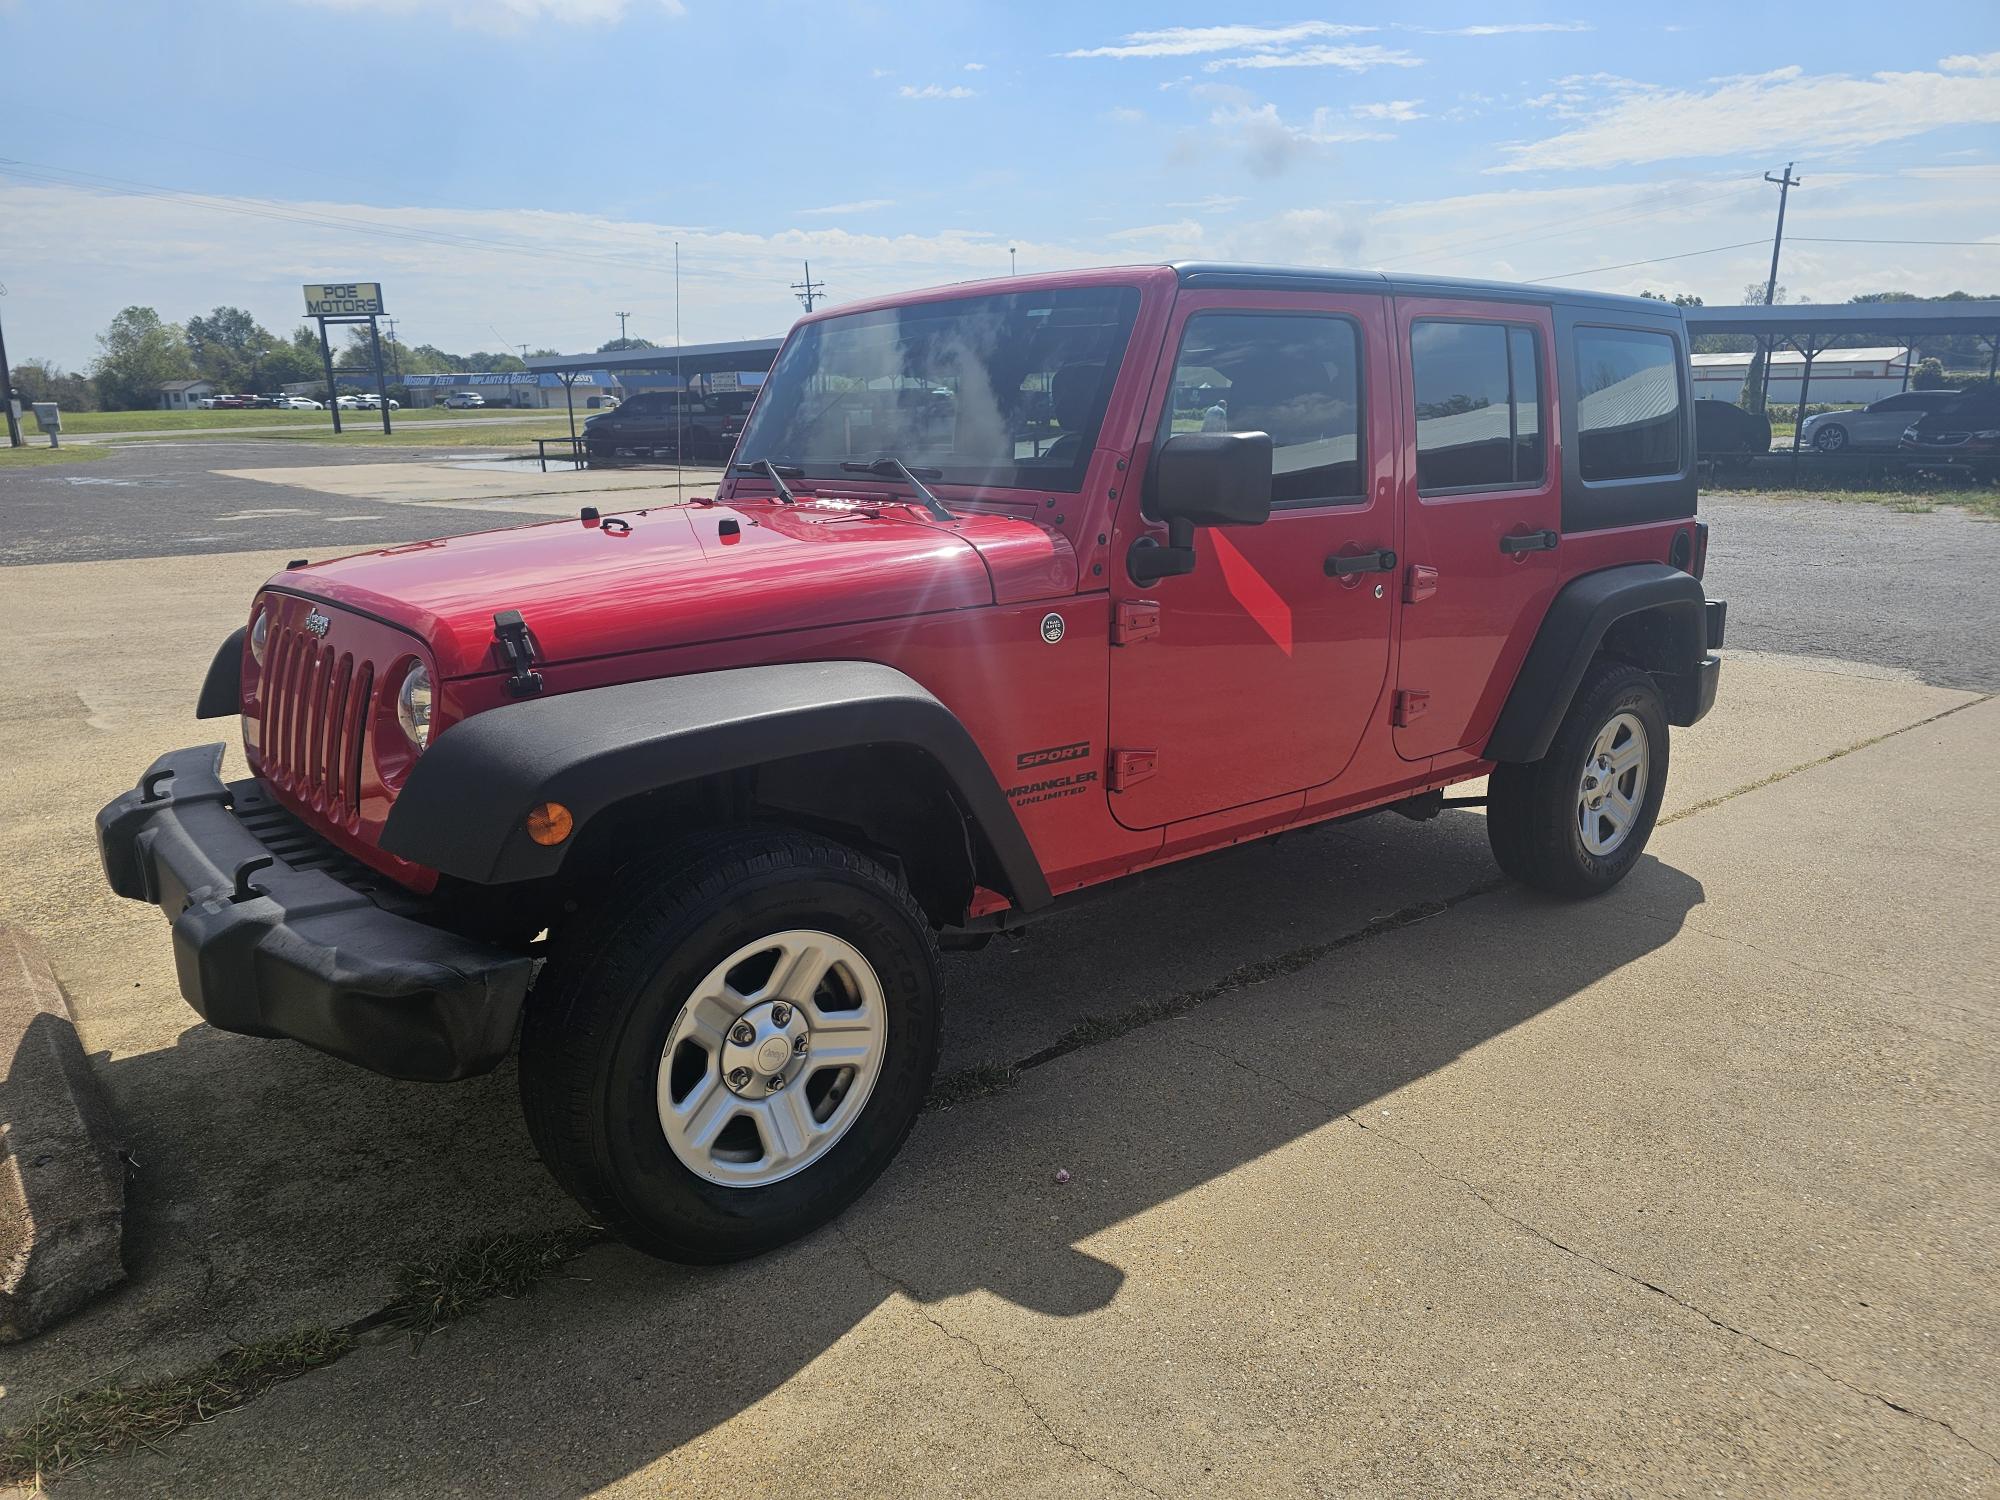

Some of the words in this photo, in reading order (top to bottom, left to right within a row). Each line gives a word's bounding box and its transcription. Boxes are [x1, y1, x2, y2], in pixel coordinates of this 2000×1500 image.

[323, 286, 357, 299] POE
[307, 299, 378, 313] MOTORS
[468, 374, 503, 385] IMPLANTS
[1019, 743, 1088, 767] SPORT
[1016, 786, 1086, 806] UNLIMITED
